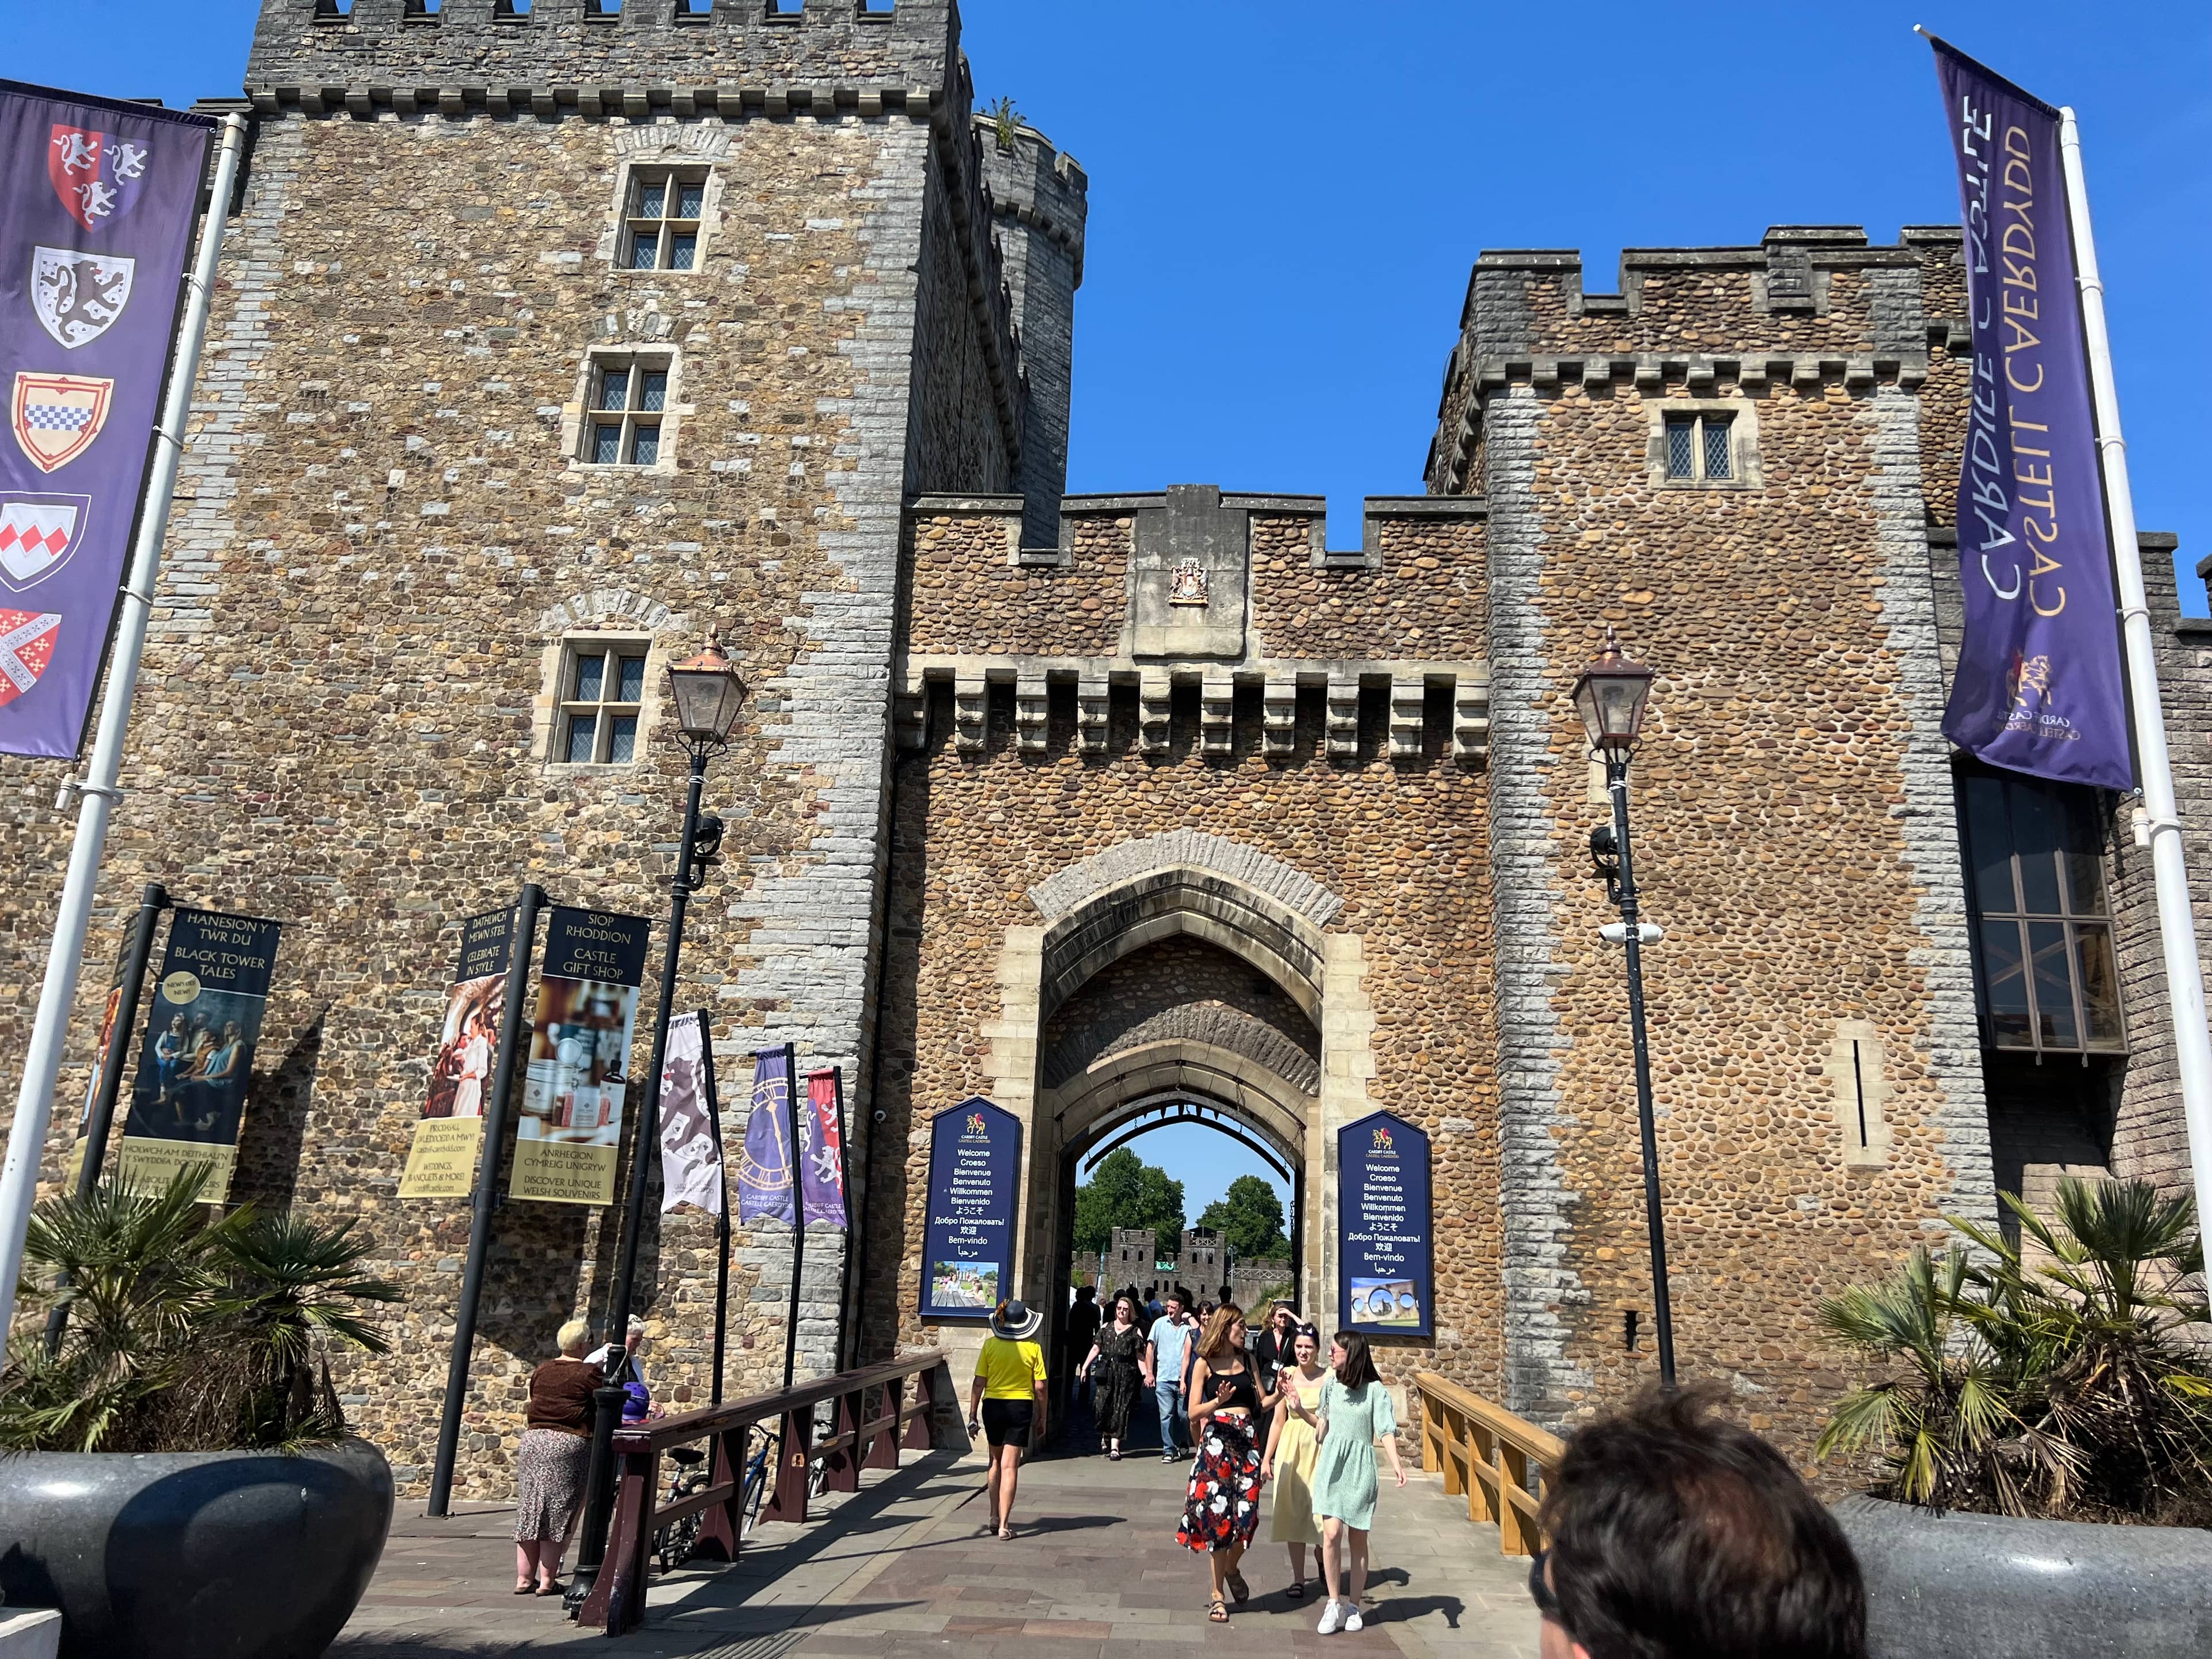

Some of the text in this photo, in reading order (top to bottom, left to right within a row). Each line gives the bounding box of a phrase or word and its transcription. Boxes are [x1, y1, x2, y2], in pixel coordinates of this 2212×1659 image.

[188, 912, 268, 934] HANESION Y
[472, 910, 507, 929] DATHLWCH
[588, 914, 614, 927] SIOP
[232, 933, 251, 946] DU
[468, 925, 506, 944] MEWN STEIL
[566, 925, 631, 945] RHODDION
[175, 946, 266, 969] BLACK TOWER
[467, 945, 500, 963] CELEBRATE
[574, 948, 616, 964] CASTLE
[199, 964, 236, 979] TALES
[466, 960, 495, 976] IN STYLE
[563, 961, 623, 979] GIFT SHOP
[124, 1145, 162, 1154] HOLWCH
[165, 1148, 179, 1157] AM
[540, 1149, 593, 1160] ANRHEGION
[133, 1155, 171, 1164] SWYDDFA
[524, 1157, 607, 1172] CYMREIG UNIGRYW
[954, 1168, 991, 1176] Bienvenue
[1366, 1164, 1400, 1172] Welcome
[524, 1175, 602, 1189] DISCOVER UNIQUE
[1369, 1173, 1396, 1181] Croeso
[524, 1186, 600, 1199] WELSH SOUVENIRS
[949, 1187, 993, 1195] Willkommen
[1363, 1183, 1403, 1192] Bienvenue
[951, 1197, 990, 1205] Bienvenido
[1363, 1193, 1403, 1202] Benvenuto
[956, 1206, 984, 1215] ようこそ
[1361, 1203, 1406, 1212] Willkommen
[934, 1217, 1005, 1226] Добро Пожаловать!
[1363, 1213, 1404, 1221] Bienvenido
[960, 1226, 977, 1235] 欢迎
[1369, 1222, 1398, 1232] ようこそ
[948, 1236, 988, 1244] Bem-vindo
[1348, 1232, 1421, 1243] Добро Пожаловать!
[1375, 1242, 1392, 1252] 欢迎
[1363, 1252, 1404, 1262] Bem-vindo
